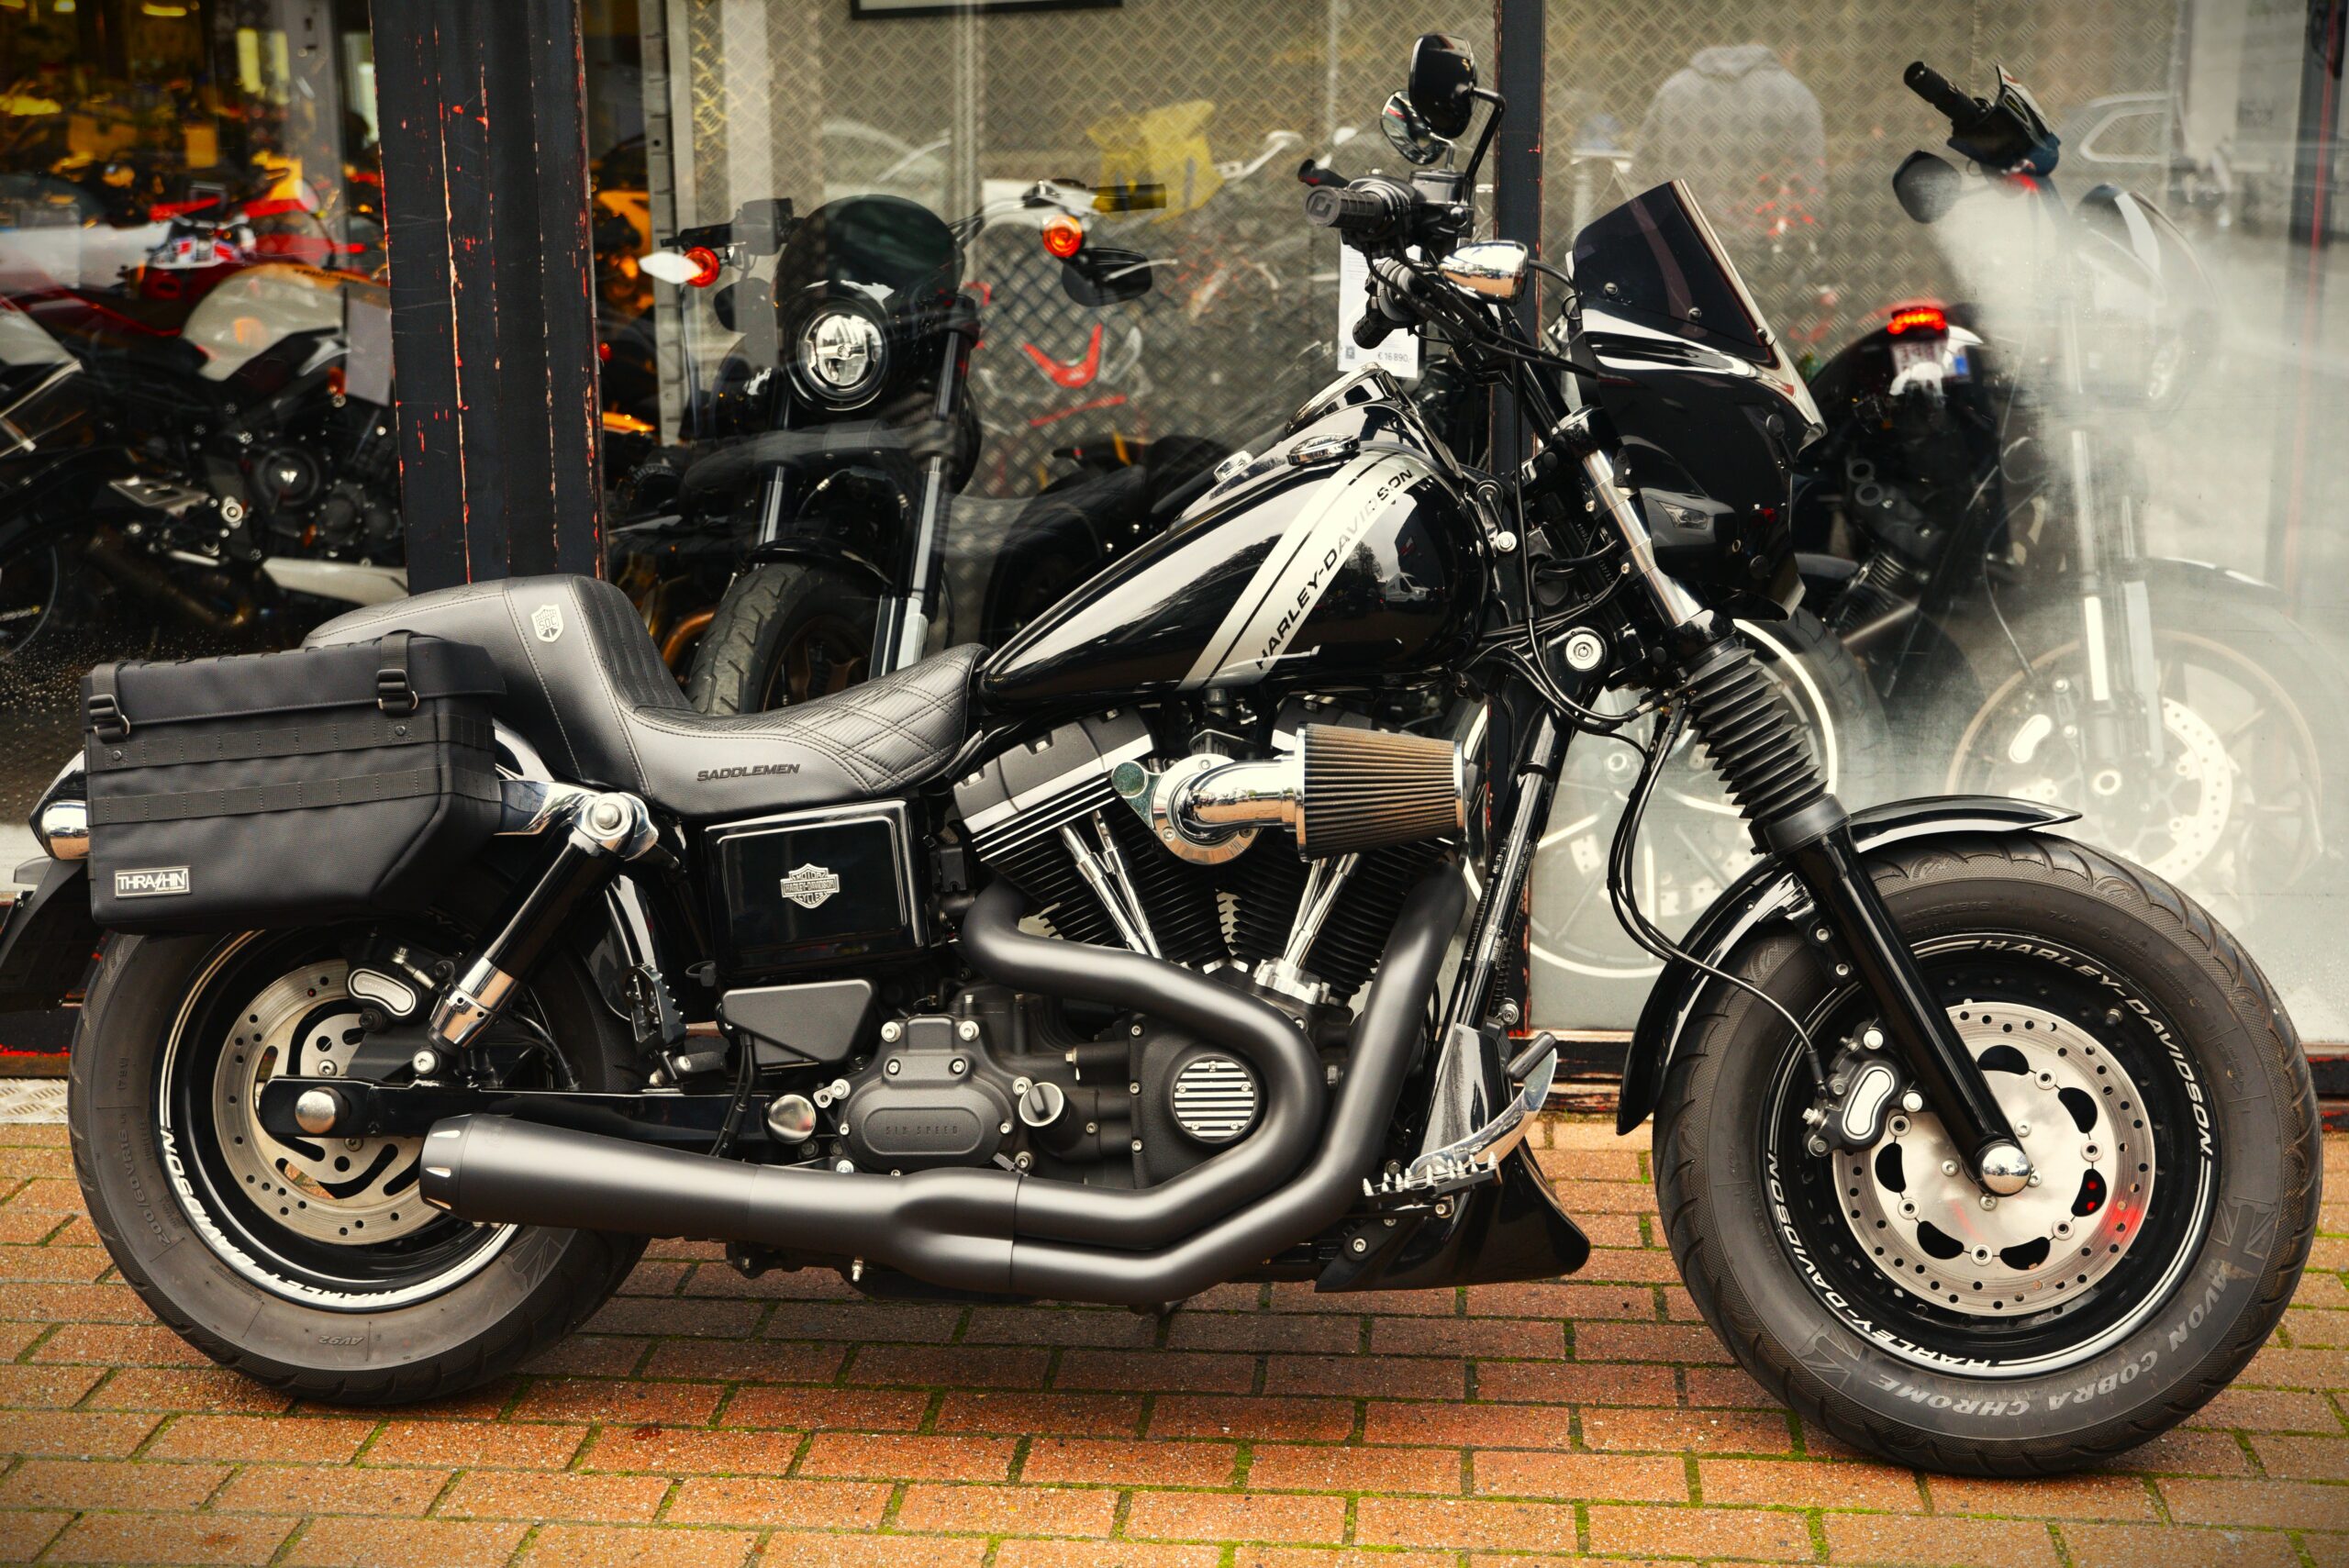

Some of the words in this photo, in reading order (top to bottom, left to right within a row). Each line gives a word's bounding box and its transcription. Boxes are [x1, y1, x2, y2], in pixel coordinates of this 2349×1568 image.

[1255, 469, 1414, 671] HARLEY-DAVIDSON
[696, 763, 801, 782] SADDLEMEN
[785, 879, 835, 893] HARLEY-DAVIDSON
[1978, 939, 2213, 1157] HARLEY-DAVIDSON
[885, 1125, 907, 1136] SIX
[916, 1125, 958, 1136] SPEED
[160, 1129, 395, 1303] HARLEY-DAVIDSON
[1767, 1152, 1992, 1372] HARLEY-DAVIDSON
[2168, 1259, 2229, 1353] AVON
[317, 1335, 365, 1346] AV92
[1868, 1373, 2031, 1417] CHROME
[2046, 1352, 2159, 1412] COBRA
